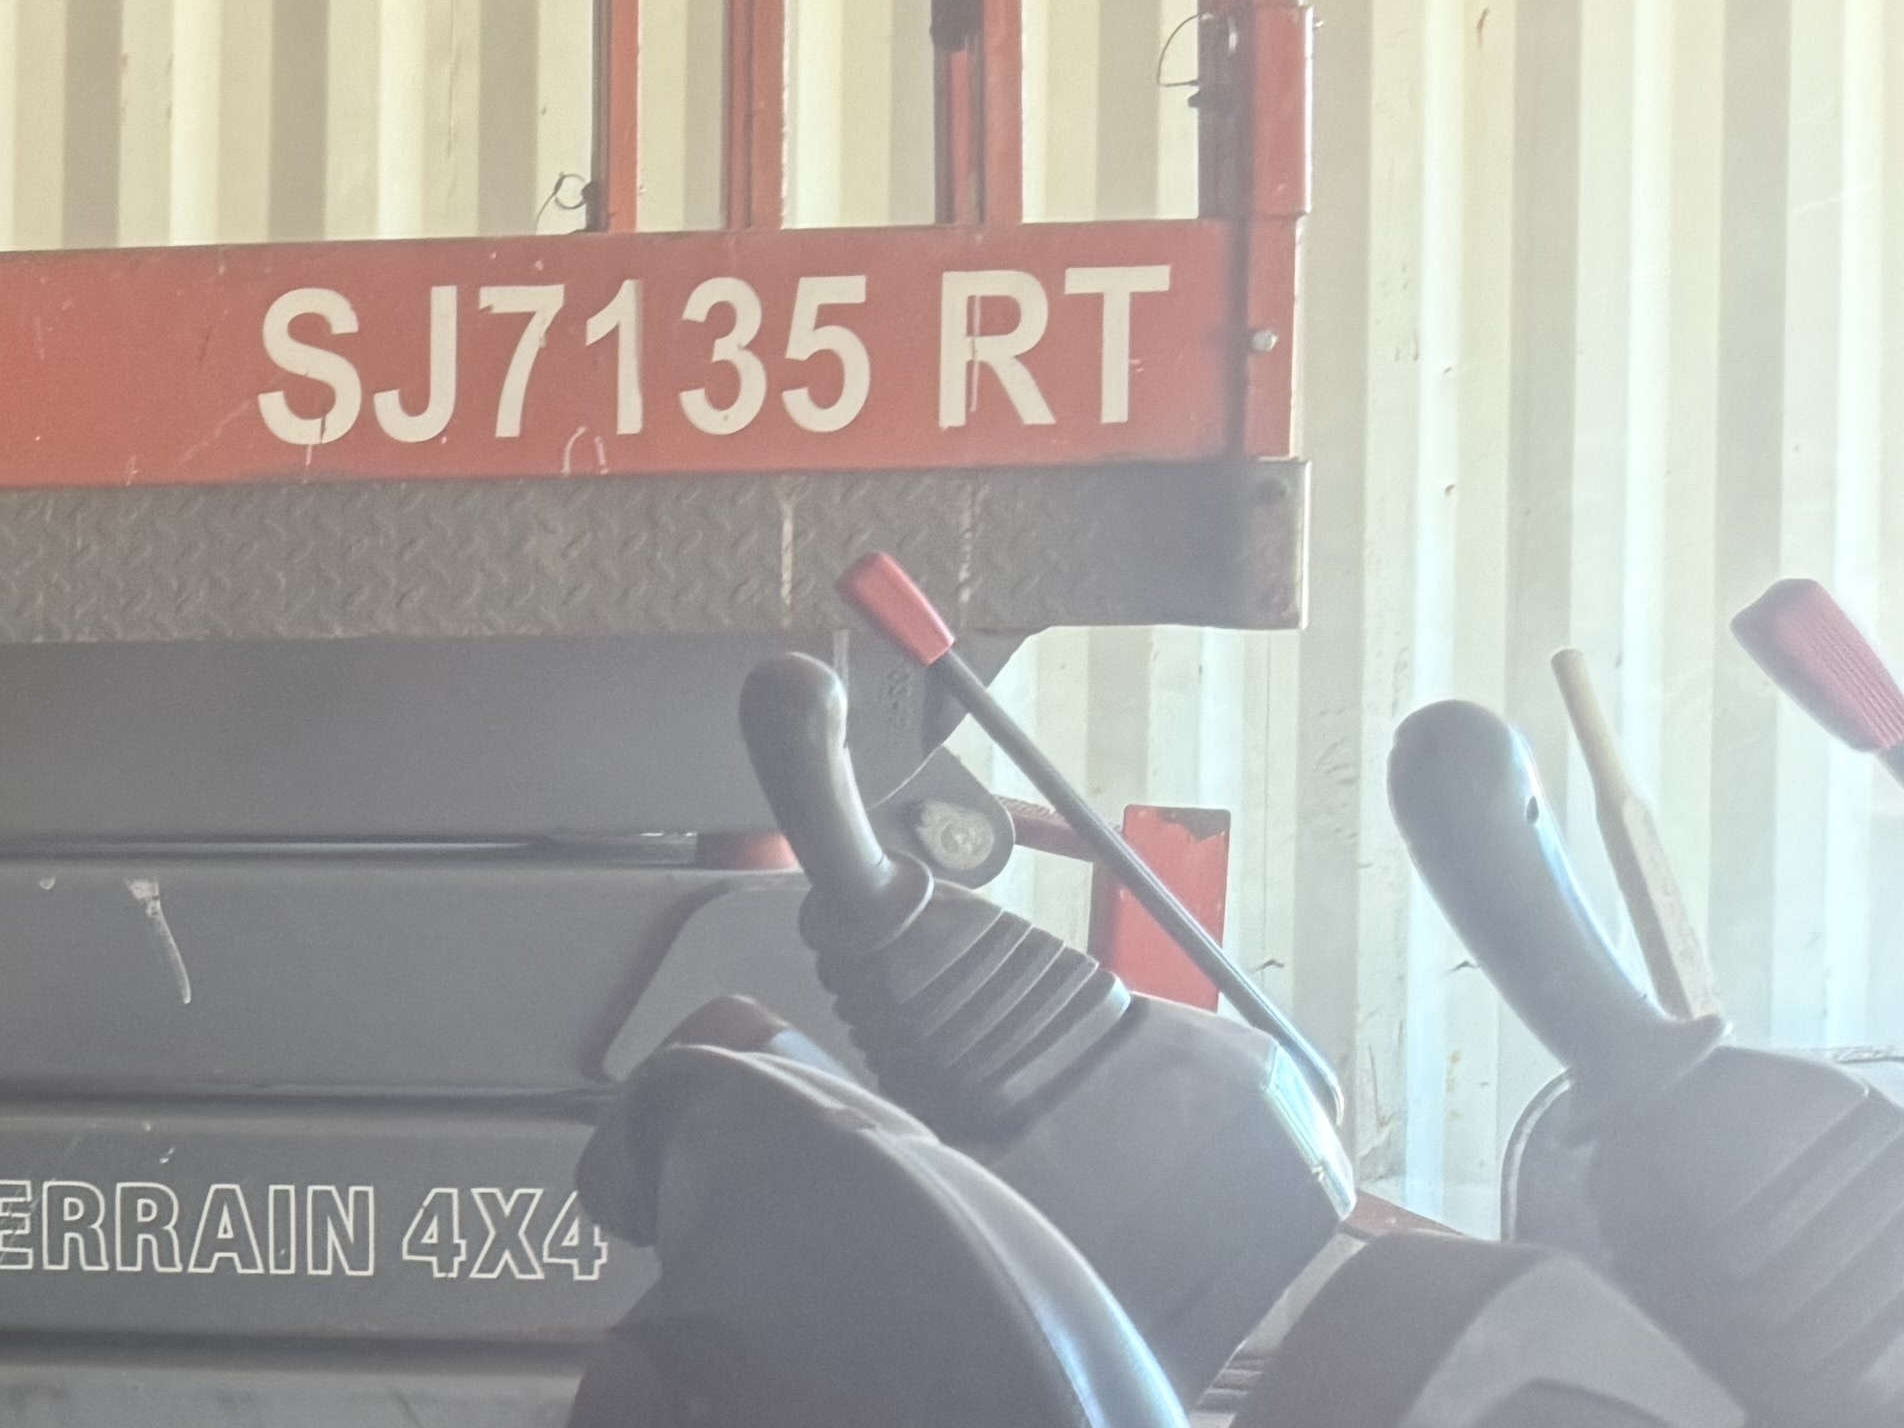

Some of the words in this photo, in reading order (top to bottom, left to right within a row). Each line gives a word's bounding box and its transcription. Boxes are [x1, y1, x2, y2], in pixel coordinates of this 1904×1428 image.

[257, 275, 871, 446] SJ7135
[937, 264, 1172, 429] RT
[399, 1186, 610, 1283] 4X4
